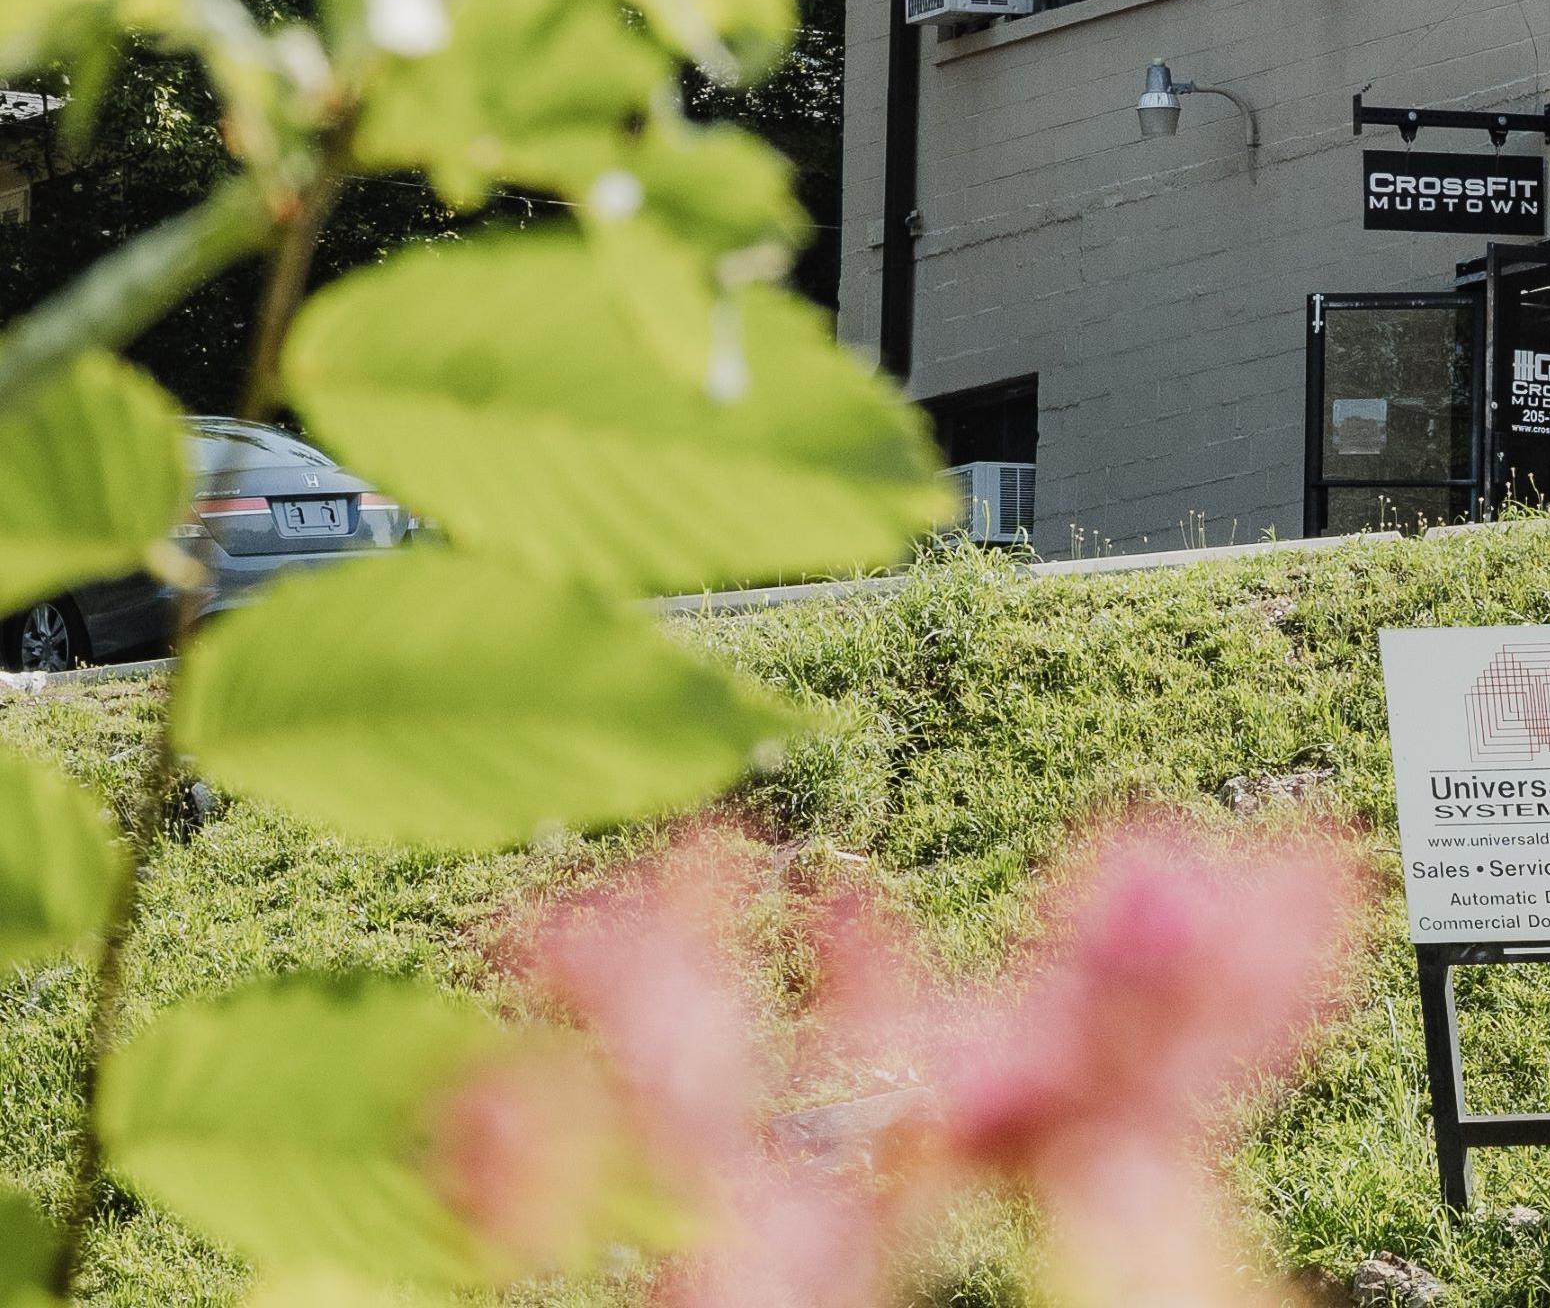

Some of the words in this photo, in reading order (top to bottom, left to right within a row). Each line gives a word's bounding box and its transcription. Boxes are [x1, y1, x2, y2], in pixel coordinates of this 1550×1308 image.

[1369, 195, 1538, 215] MUDTOWN
[1412, 861, 1470, 879] Sales
[1450, 891, 1538, 907] Automatic
[1418, 915, 1521, 931] Commercial
